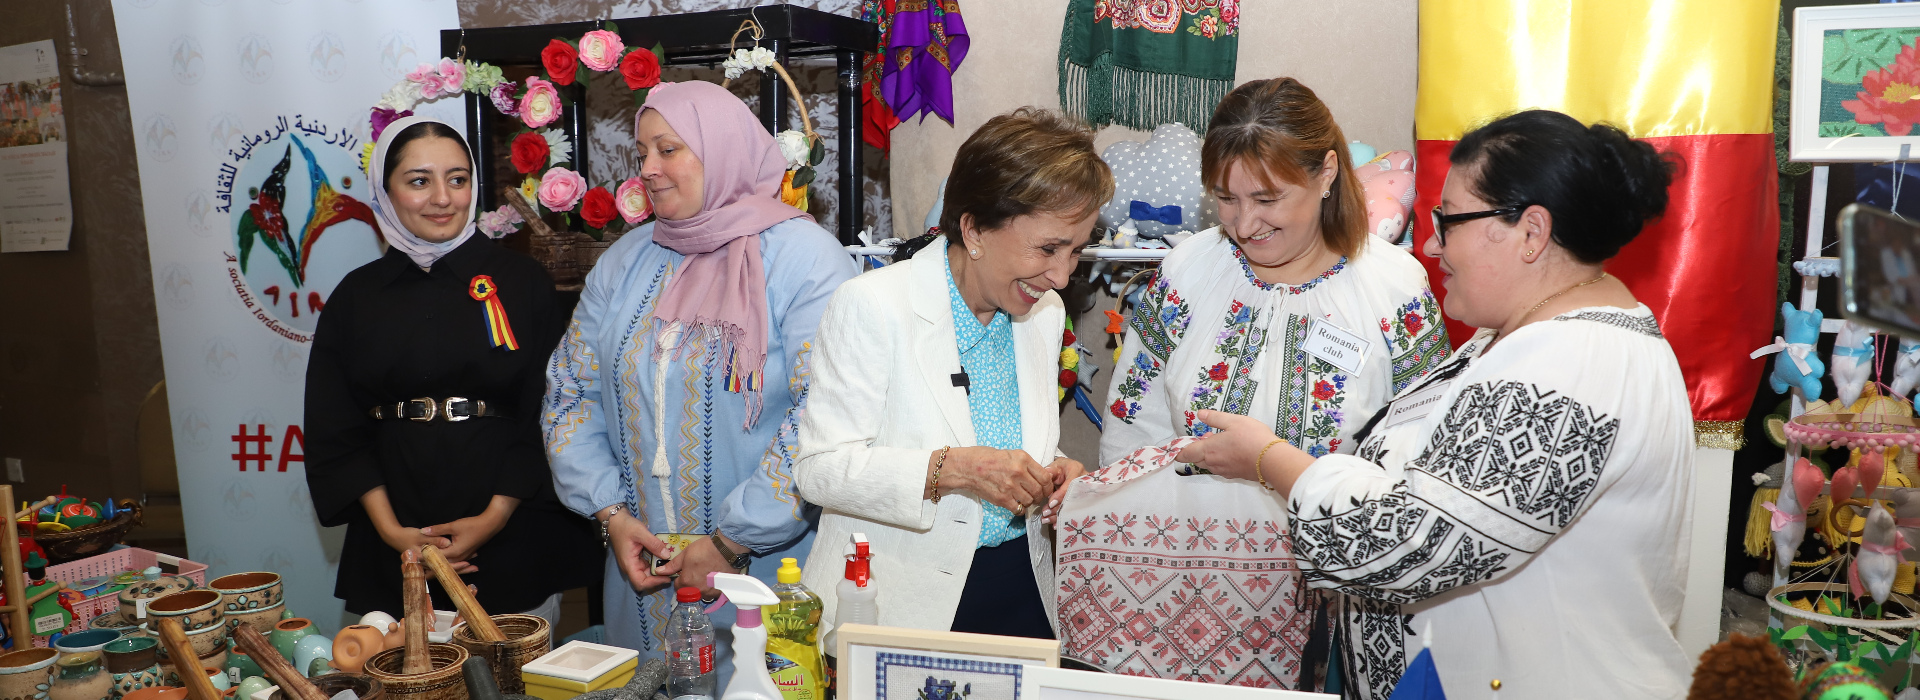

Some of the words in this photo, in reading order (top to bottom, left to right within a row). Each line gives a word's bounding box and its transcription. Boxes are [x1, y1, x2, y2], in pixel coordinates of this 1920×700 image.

[232, 115, 289, 162] الرومانية
[215, 162, 238, 213] للثقافة
[228, 266, 254, 309] sociatia
[1317, 327, 1360, 353] Romania
[1322, 346, 1343, 360] club
[1394, 394, 1443, 416] Romania
